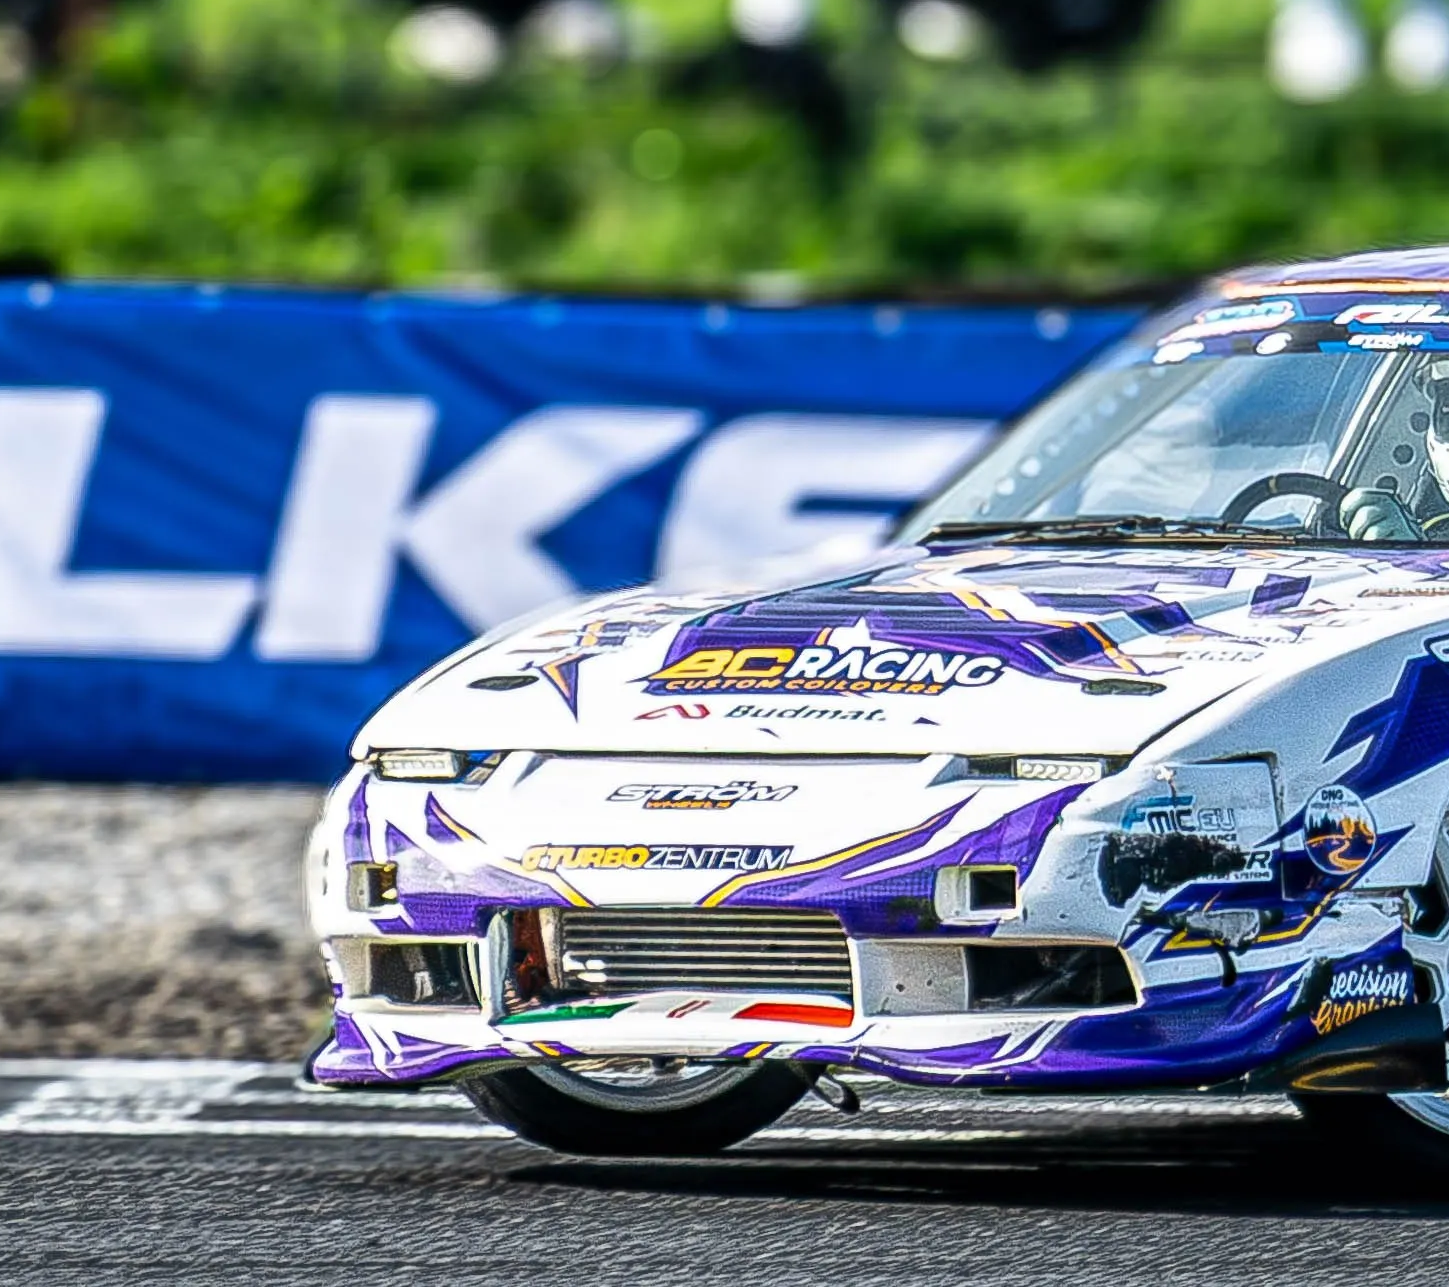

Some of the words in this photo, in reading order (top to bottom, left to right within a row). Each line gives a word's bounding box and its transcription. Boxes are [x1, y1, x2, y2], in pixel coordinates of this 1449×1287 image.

[784, 645, 1004, 687] RACING
[665, 679, 779, 692] CUSTOM
[785, 679, 946, 694] COILOVERS
[606, 781, 799, 802] STRÖM
